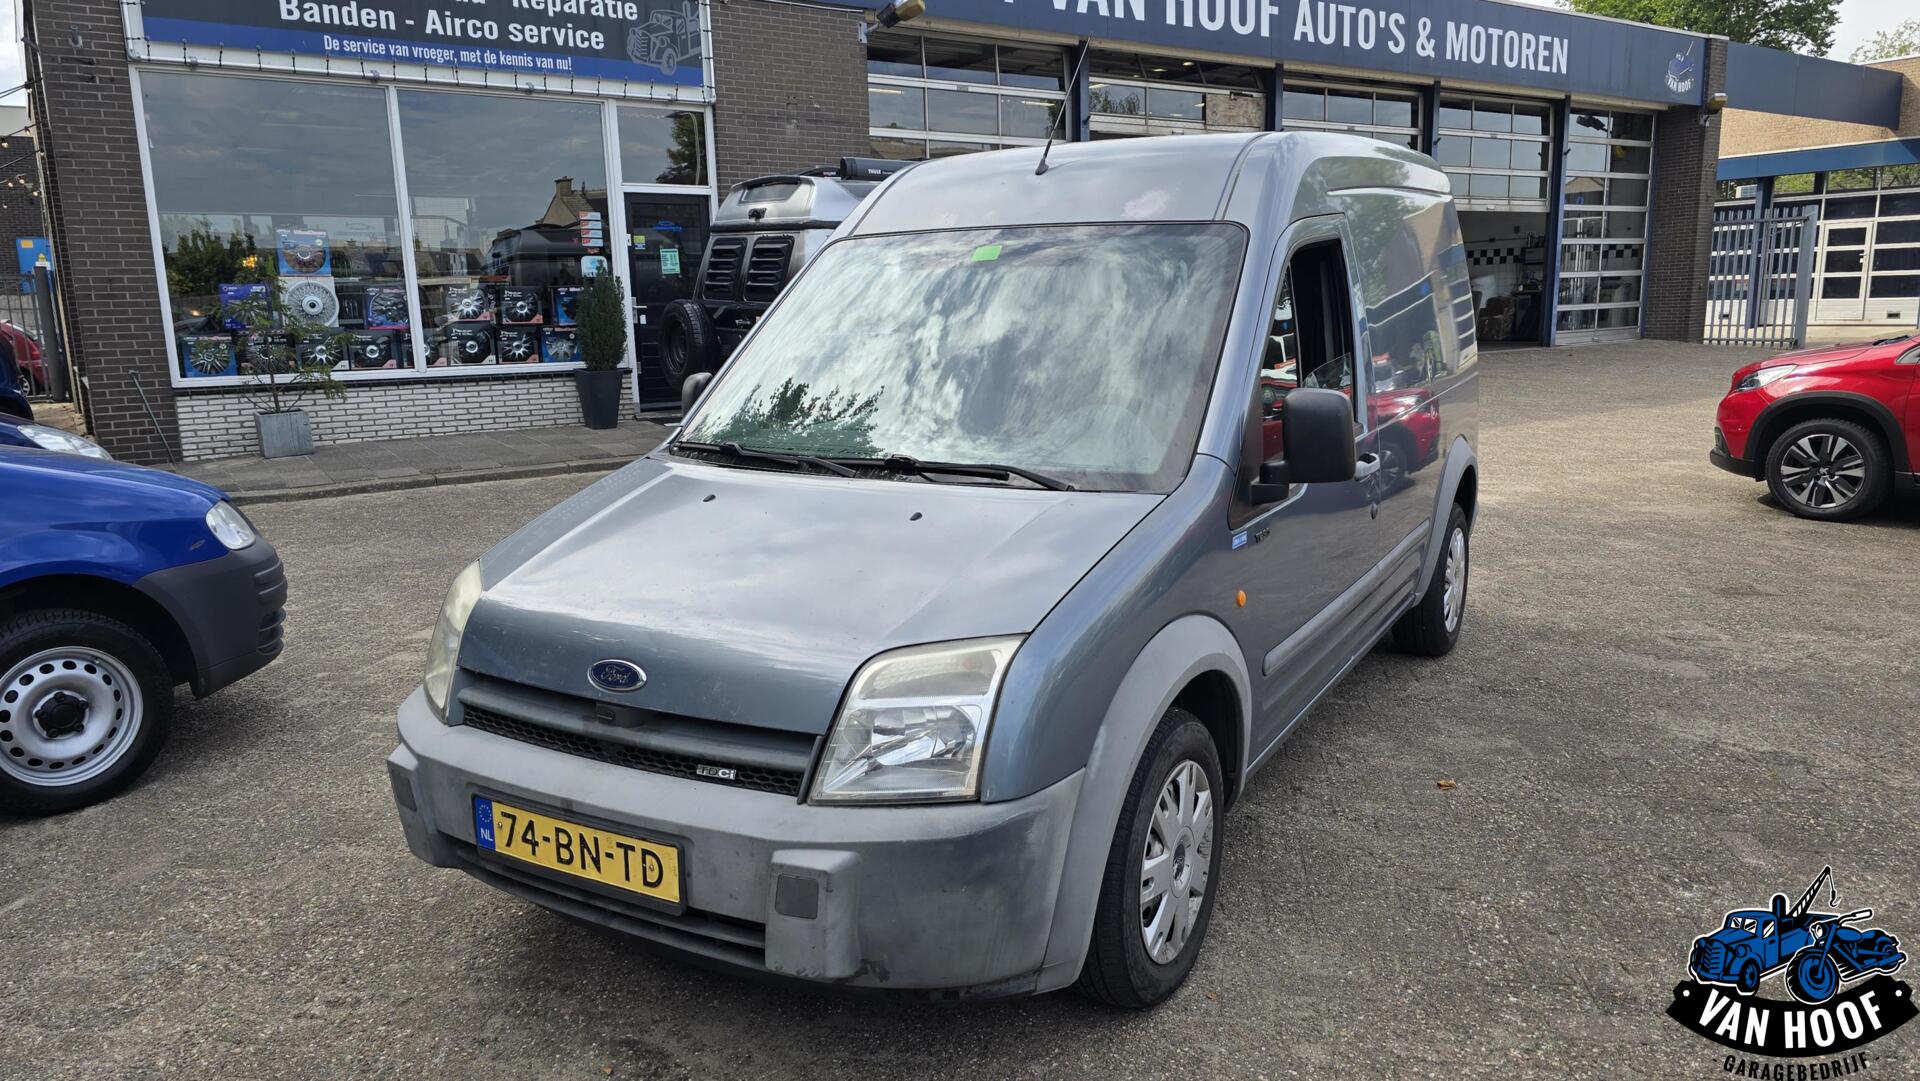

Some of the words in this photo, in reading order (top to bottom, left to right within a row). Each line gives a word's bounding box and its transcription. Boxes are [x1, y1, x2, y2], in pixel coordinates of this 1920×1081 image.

[279, 0, 397, 30] Banden
[425, 9, 499, 40] Airco
[508, 22, 605, 50] service
[1294, 0, 1405, 53] AUTO'S
[1416, 17, 1435, 58] &
[1446, 21, 1568, 74] MOTOREN
[323, 35, 340, 51] De
[343, 38, 386, 54] service
[389, 44, 409, 56] van
[412, 46, 457, 63] vroeger,
[460, 50, 482, 63] met
[484, 49, 497, 64] de
[499, 52, 533, 67] kennis
[535, 56, 554, 69] van
[556, 57, 572, 70] nu!
[601, 664, 629, 684] Ford
[480, 828, 494, 843] NL
[500, 810, 664, 889] 74-BN-TD
